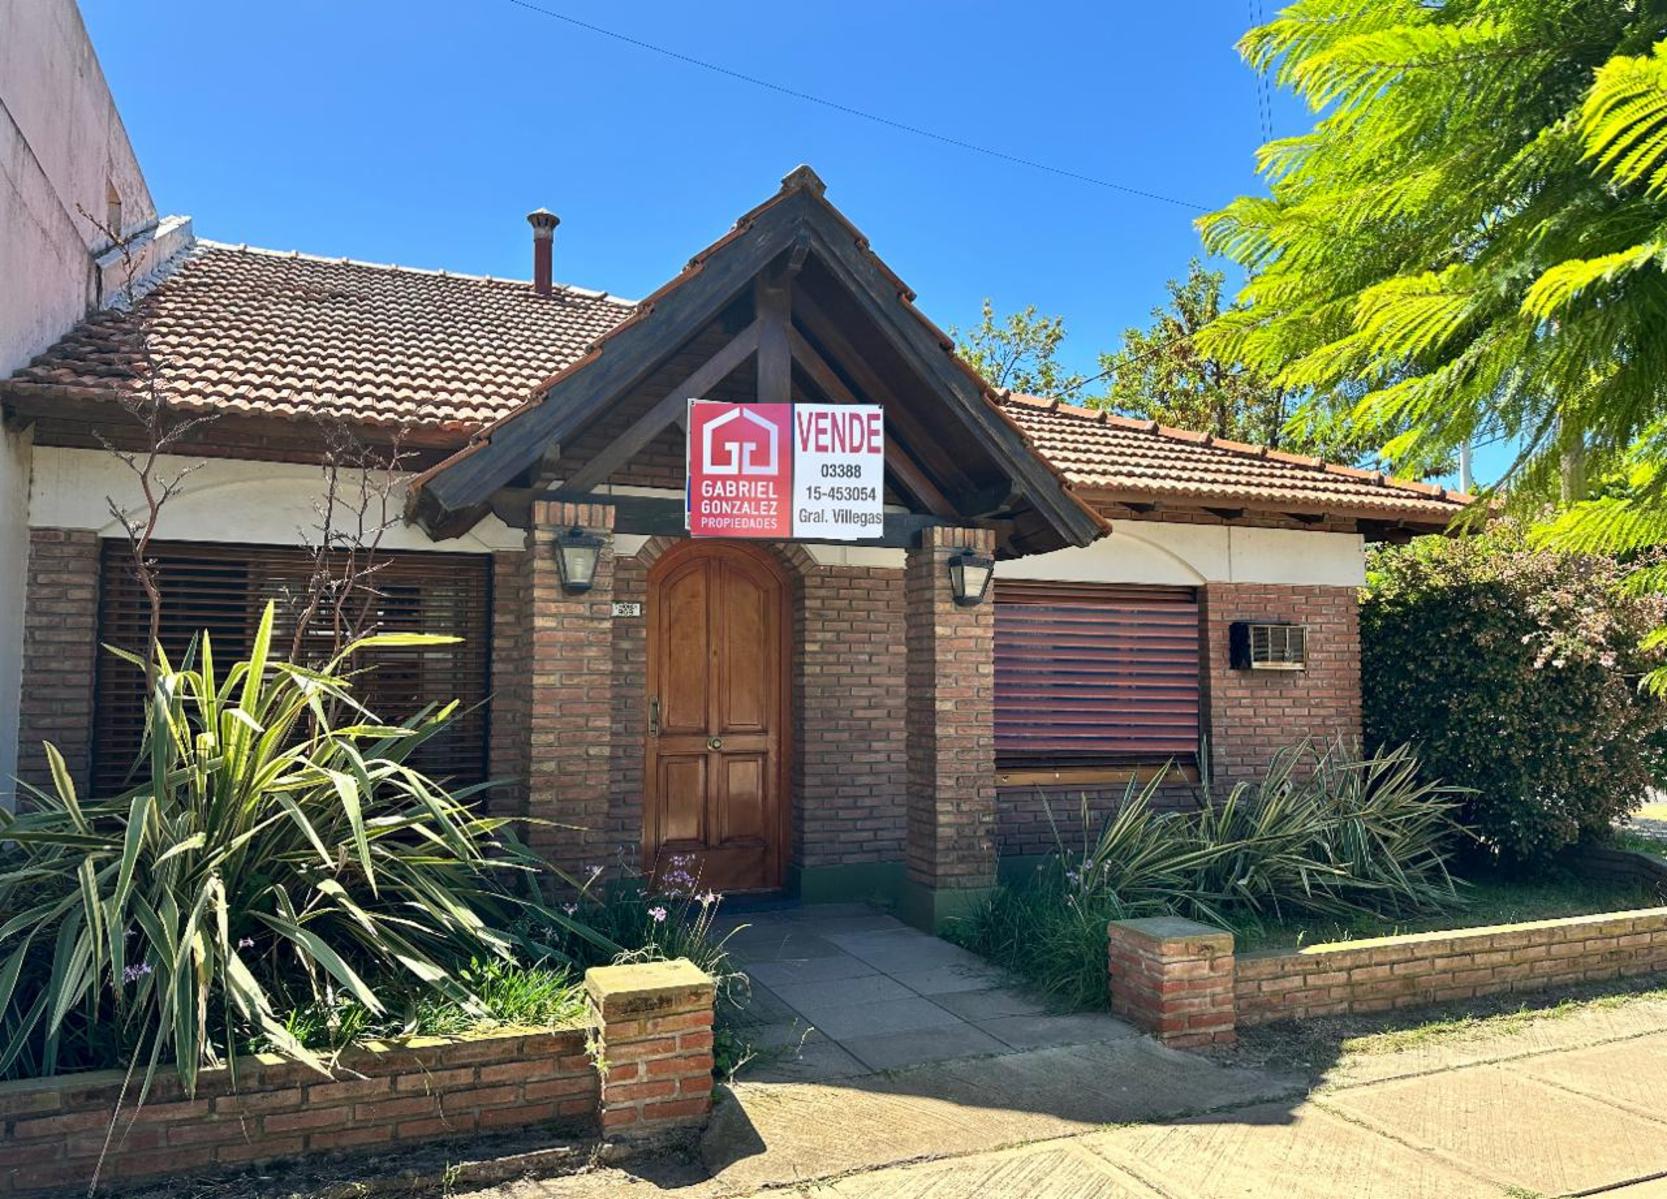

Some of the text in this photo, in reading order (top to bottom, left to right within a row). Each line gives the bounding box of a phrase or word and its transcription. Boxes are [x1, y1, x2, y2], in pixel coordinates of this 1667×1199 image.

[797, 411, 882, 454] VENDE
[821, 463, 862, 478] 03388
[702, 480, 778, 498] GABRIEL
[806, 485, 876, 501] 15-453054
[702, 500, 778, 515] GONZALEZ
[701, 517, 778, 529] PROPIEDADES
[799, 508, 882, 527] Gral. Villegas
